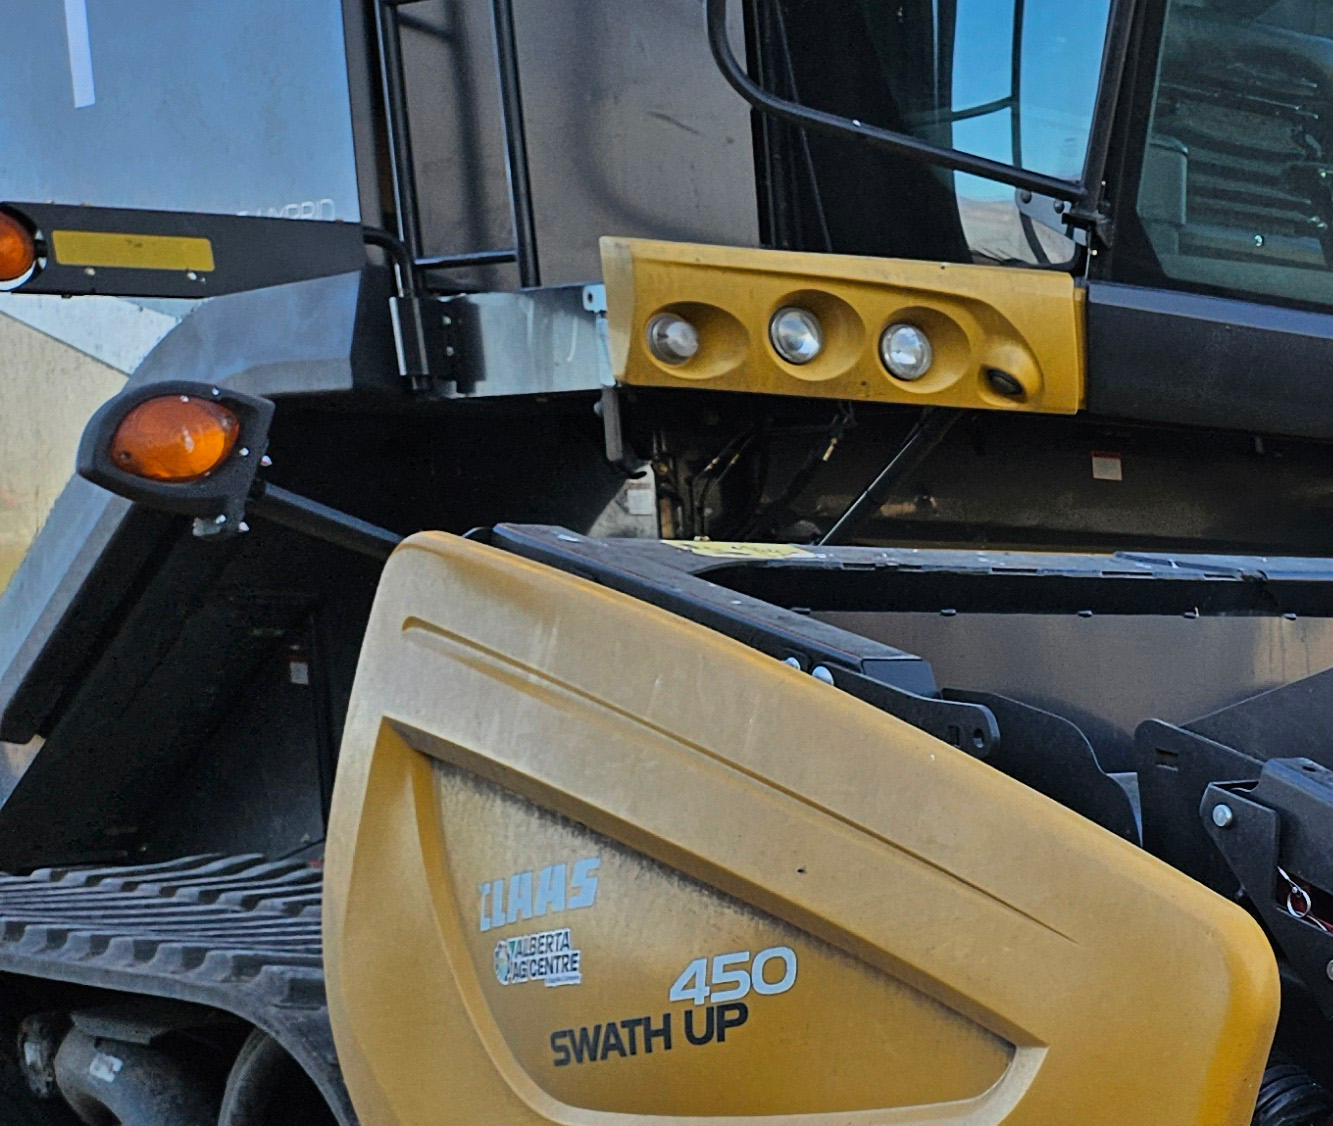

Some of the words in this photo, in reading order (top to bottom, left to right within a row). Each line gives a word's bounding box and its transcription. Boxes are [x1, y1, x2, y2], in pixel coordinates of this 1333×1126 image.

[513, 961, 527, 979] AG
[529, 953, 579, 977] CENTRE
[515, 931, 570, 959] ALBERTA
[669, 946, 798, 1005] 450
[551, 1013, 672, 1067] SWATH
[684, 1002, 748, 1045] UP
